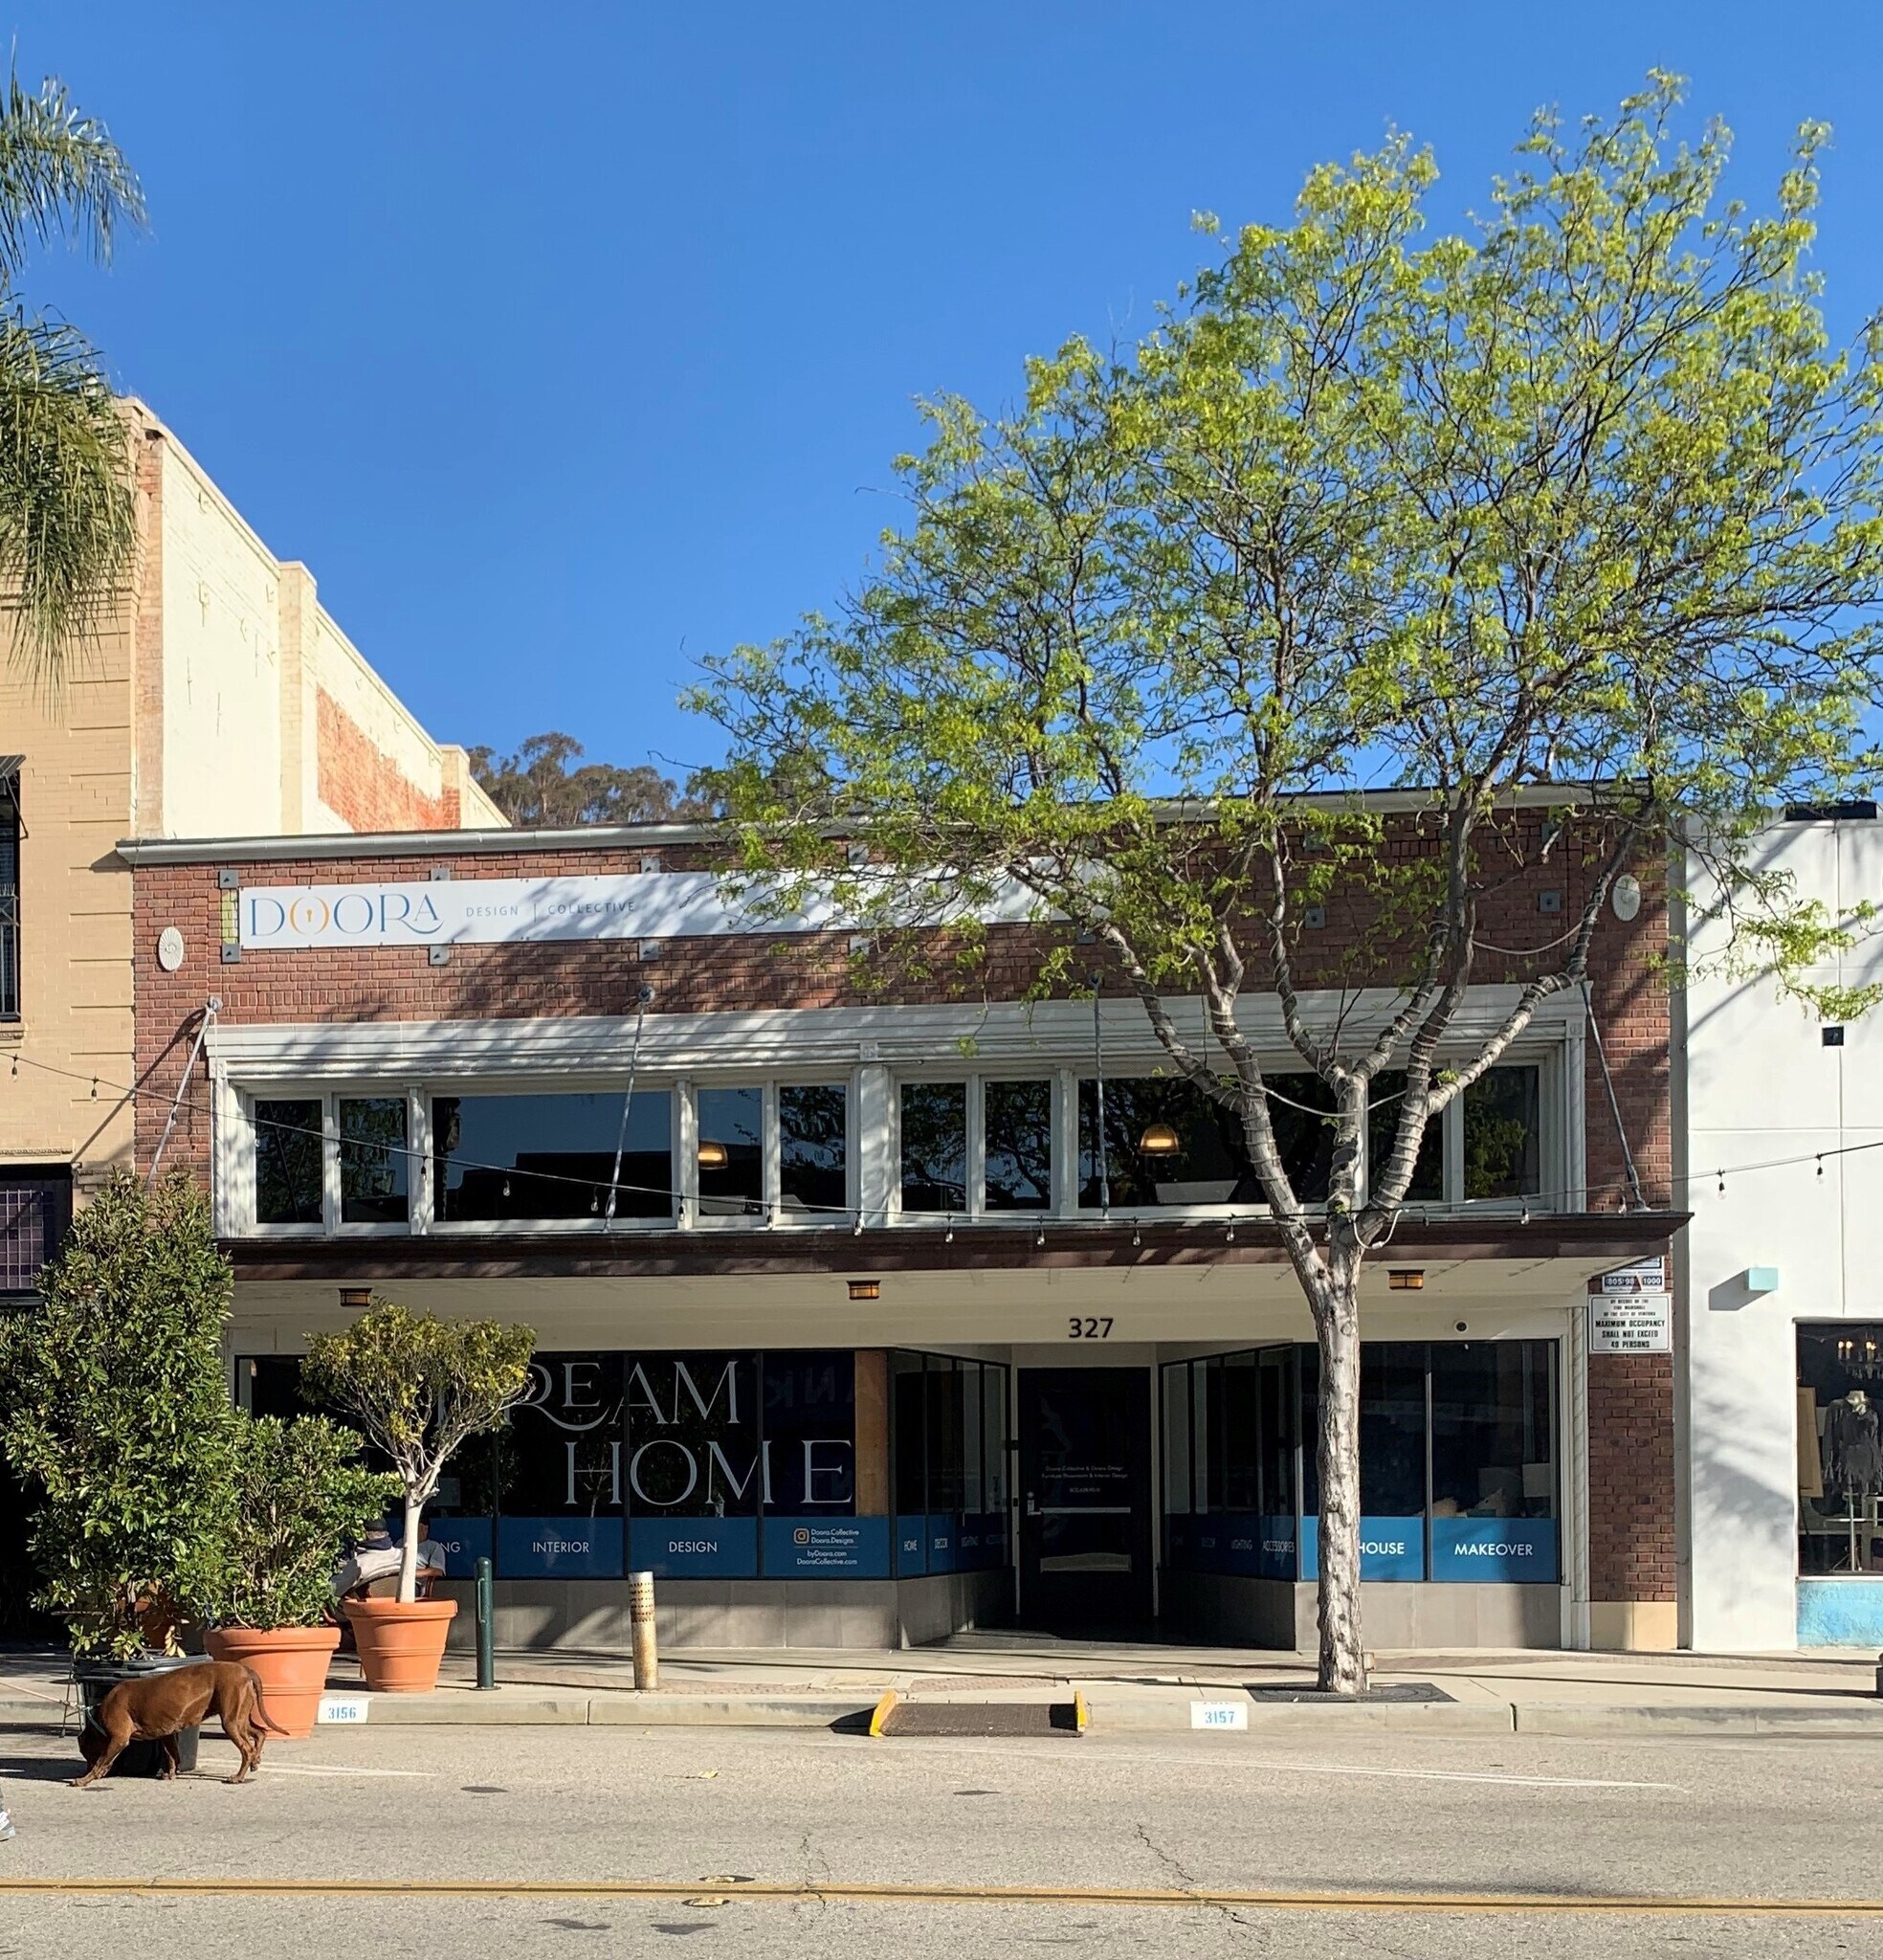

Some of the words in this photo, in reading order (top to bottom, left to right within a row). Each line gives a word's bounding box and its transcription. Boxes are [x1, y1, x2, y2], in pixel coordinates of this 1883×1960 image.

[250, 893, 444, 936] DOORA
[465, 905, 519, 918] DESIGN
[547, 902, 635, 916] COLLECTIVE
[1069, 1318, 1114, 1338] 327
[564, 1439, 853, 1505] HOME
[532, 1542, 589, 1553] INTERIOR
[669, 1541, 718, 1553] DESIGN
[903, 1539, 918, 1551] HOME
[1454, 1543, 1533, 1556] MAKEOVER
[328, 1707, 357, 1720] 3156
[1205, 1711, 1235, 1724] 3157
